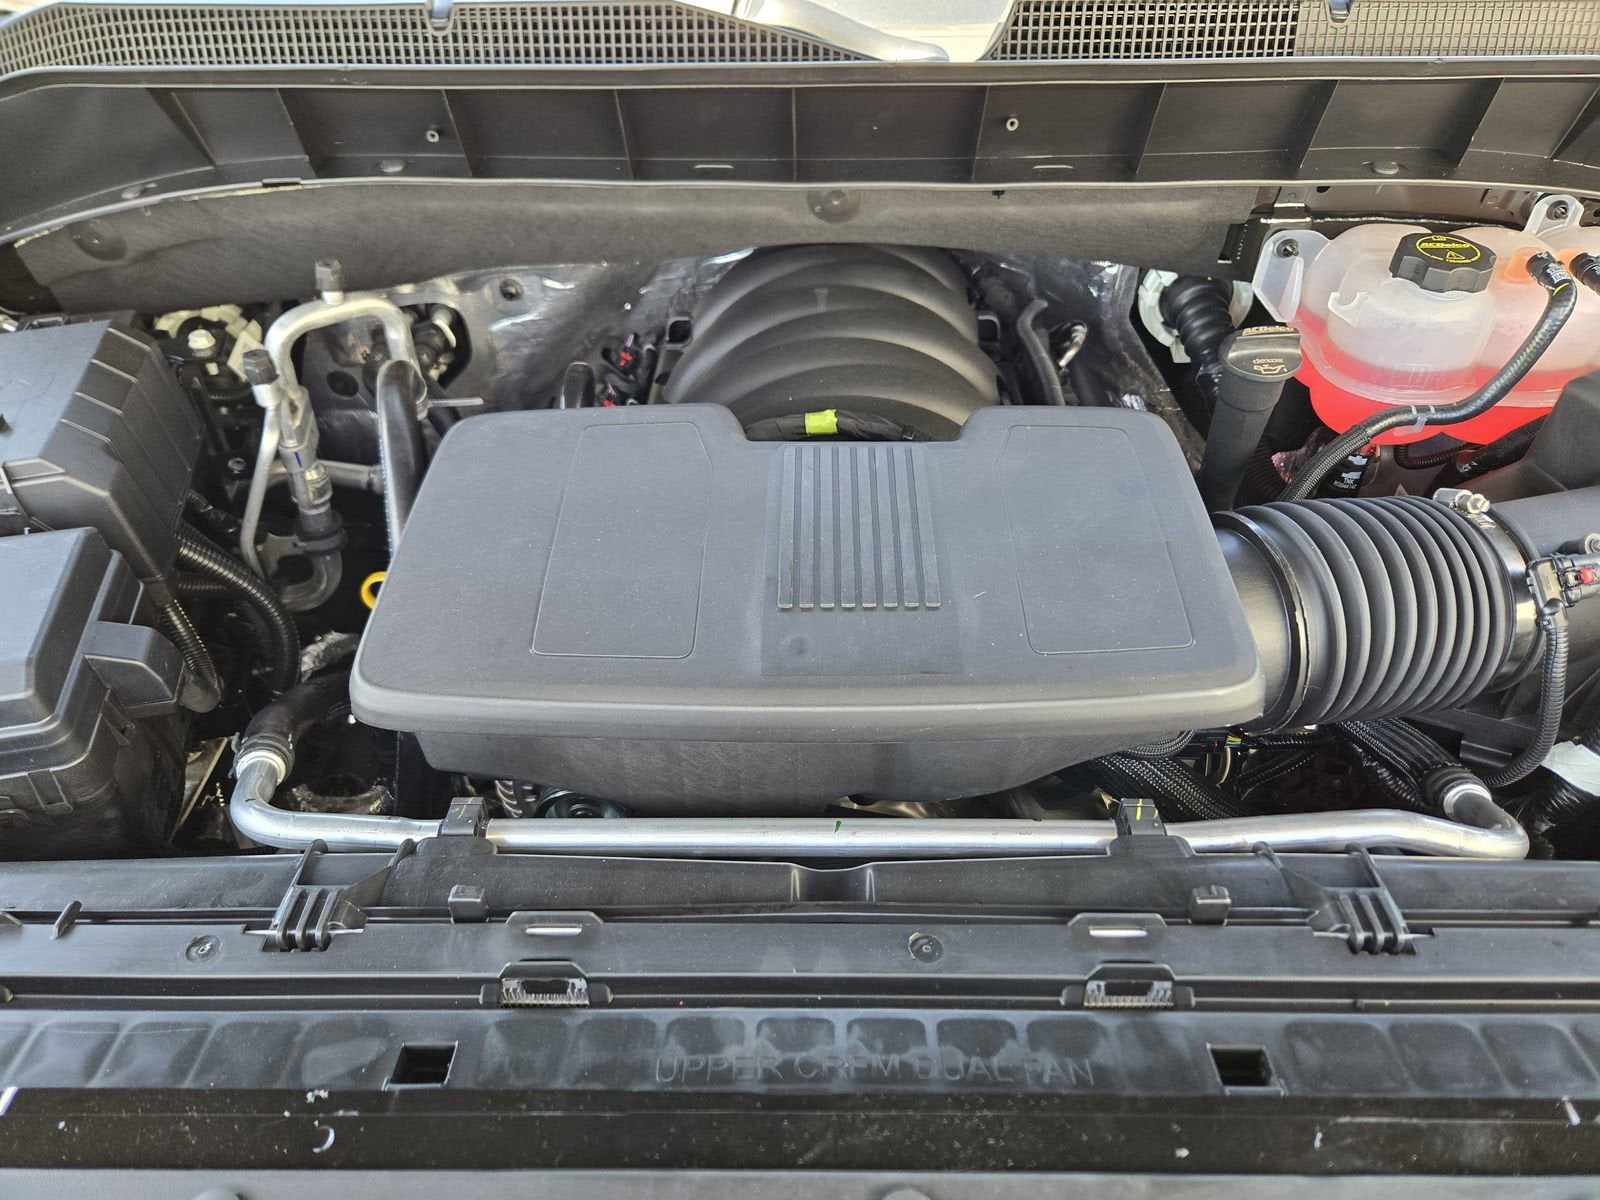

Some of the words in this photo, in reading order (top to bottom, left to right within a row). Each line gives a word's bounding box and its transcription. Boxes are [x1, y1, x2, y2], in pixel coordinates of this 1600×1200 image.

[655, 1055, 784, 1083] UPPER
[913, 1055, 1014, 1083] DUAL
[1023, 1057, 1095, 1086] FAN
